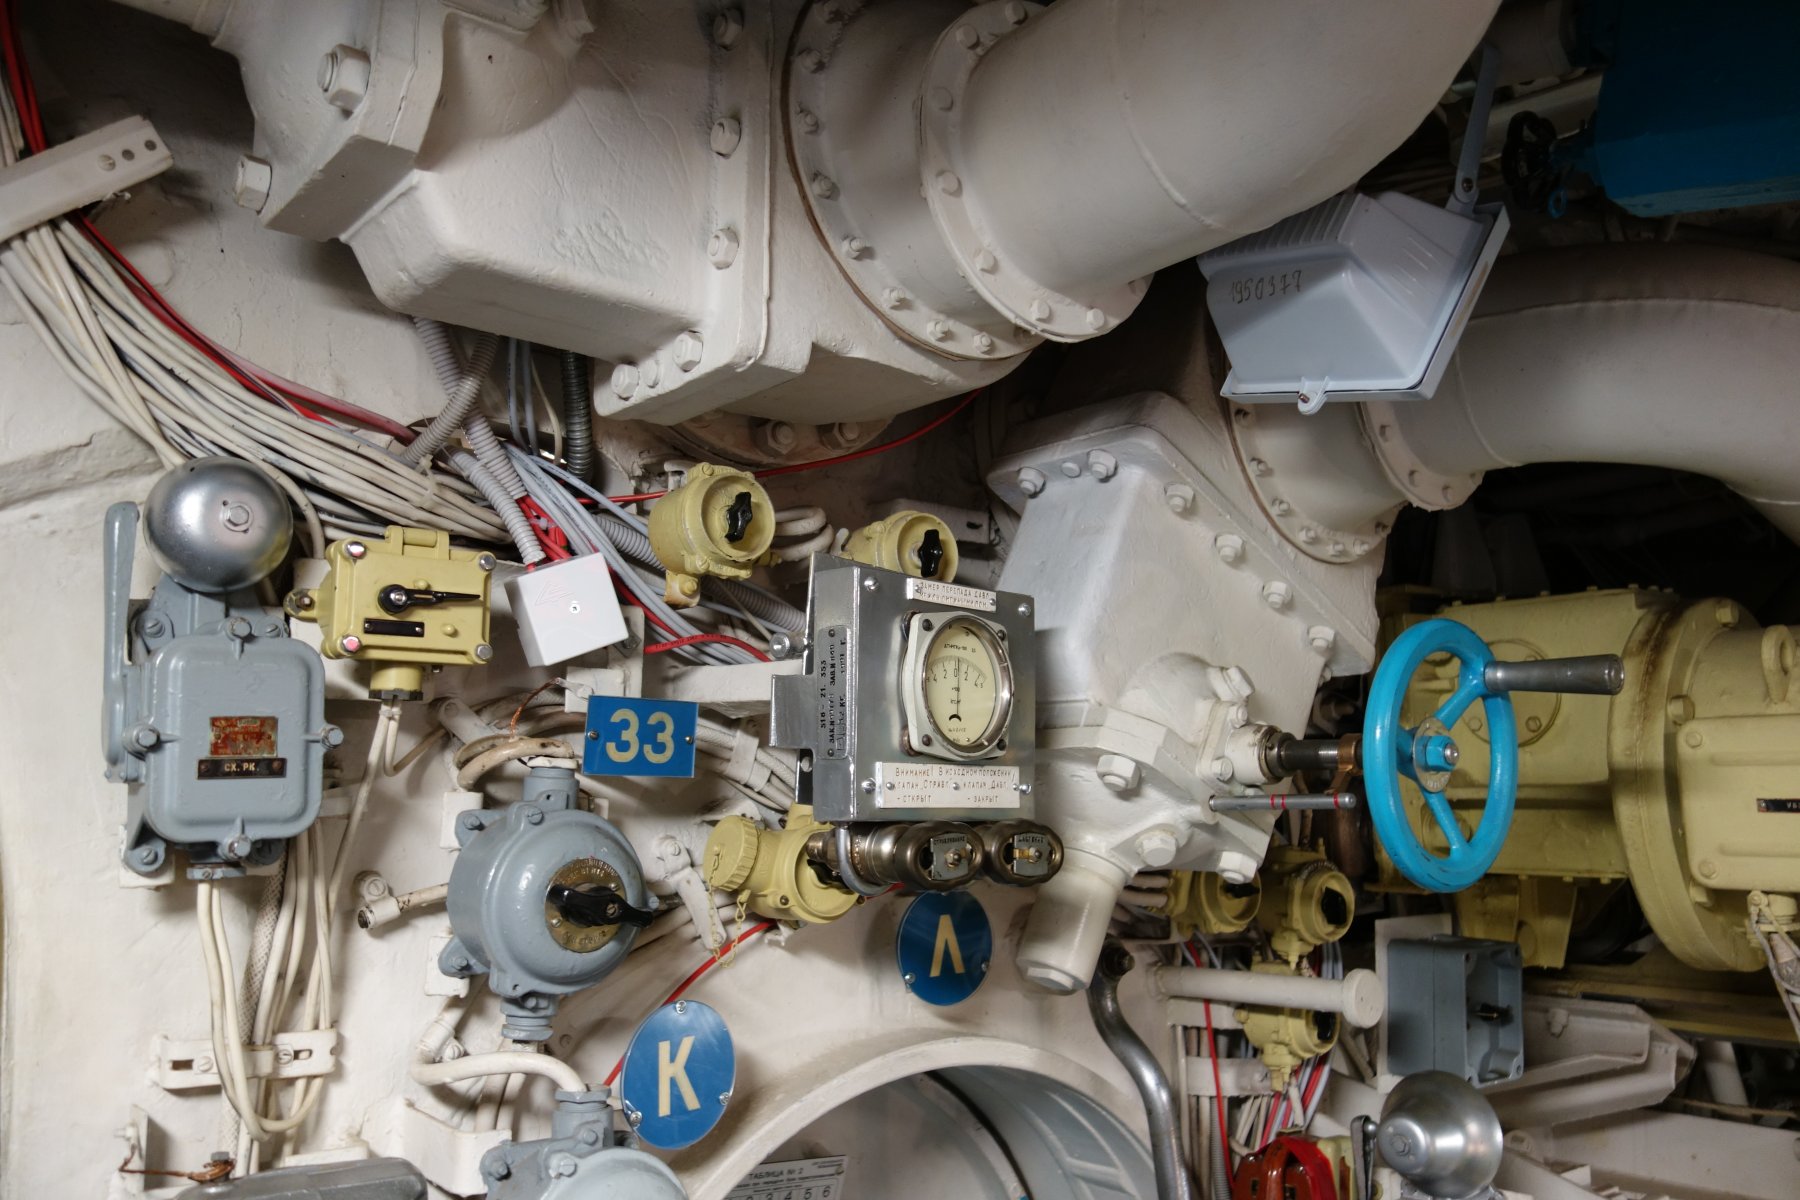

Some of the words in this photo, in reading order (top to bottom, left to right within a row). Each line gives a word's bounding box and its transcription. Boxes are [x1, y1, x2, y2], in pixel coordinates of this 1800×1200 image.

[606, 708, 675, 764] 33
[658, 1036, 701, 1117] К
[749, 1170, 784, 1180] ТАБЛИЦА
[804, 1188, 812, 1200] 5
[822, 1185, 832, 1198] 6
